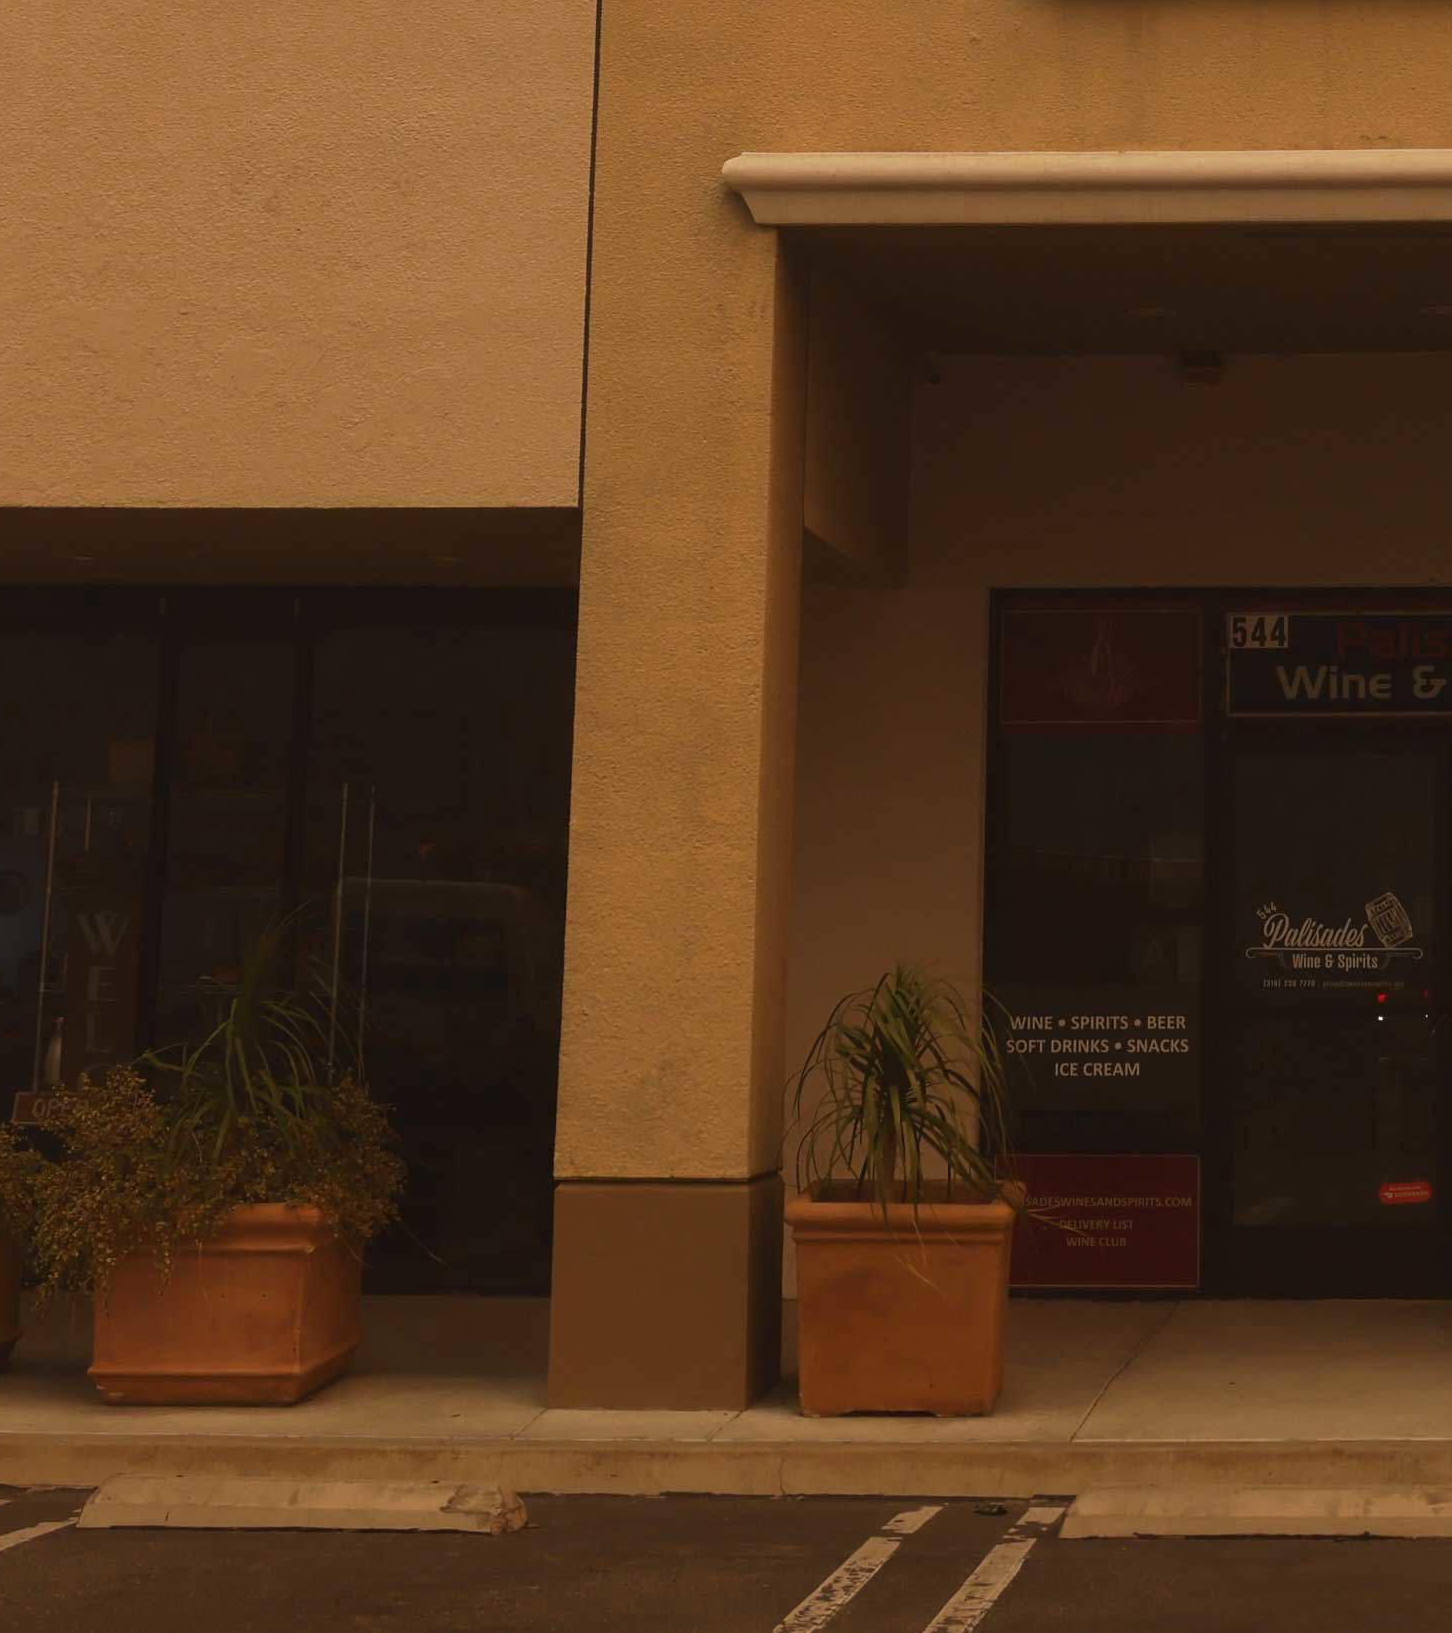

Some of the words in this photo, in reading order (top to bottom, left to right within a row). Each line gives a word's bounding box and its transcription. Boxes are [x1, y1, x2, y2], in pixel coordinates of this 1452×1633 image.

[1232, 616, 1287, 648] 544
[1276, 664, 1392, 700] Wine
[1412, 664, 1446, 700] &
[1263, 912, 1369, 949] Palisades
[1292, 954, 1321, 969] Wine
[1324, 954, 1334, 969] &
[1337, 953, 1379, 972] Spirits
[1010, 1015, 1053, 1030] WINE
[1071, 1015, 1129, 1030] SPIRITS
[1147, 1015, 1186, 1030] BEER
[1006, 1039, 1046, 1053] SOFT
[1050, 1039, 1109, 1053] DRINKS
[1126, 1039, 1189, 1053] SNACKS
[1054, 1062, 1078, 1077] ICE
[1083, 1062, 1140, 1077] CREAM
[1060, 1219, 1110, 1230] DELIVERY
[1112, 1219, 1134, 1230] LIST
[1066, 1237, 1096, 1247] WINE
[1098, 1237, 1127, 1247] CLUB
